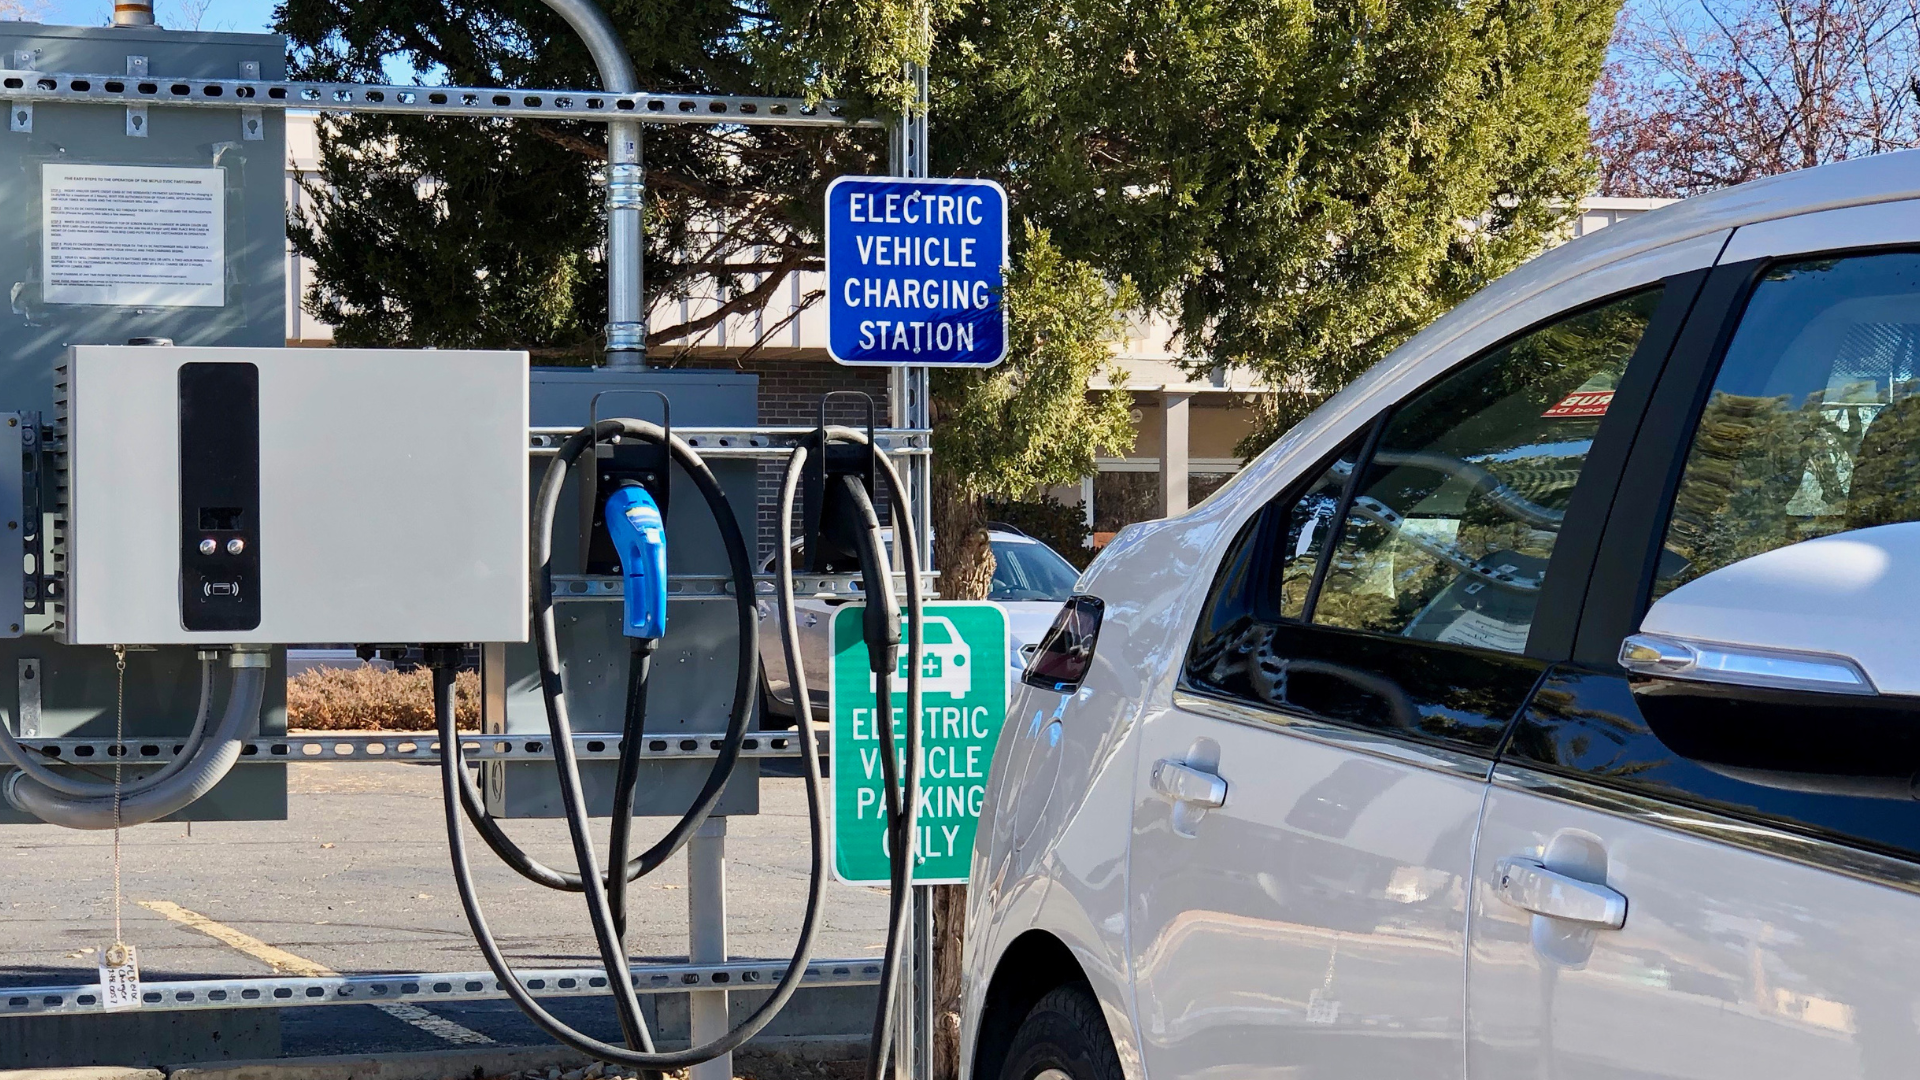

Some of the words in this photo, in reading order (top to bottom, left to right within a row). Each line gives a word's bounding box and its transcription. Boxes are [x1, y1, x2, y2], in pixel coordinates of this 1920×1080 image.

[850, 193, 983, 225] ELECTRIC
[856, 235, 977, 267] VEHICLE
[844, 277, 989, 309] CHARGING
[859, 320, 974, 351] STATION
[852, 706, 989, 740] ELETRIC
[859, 746, 983, 779] VICLE
